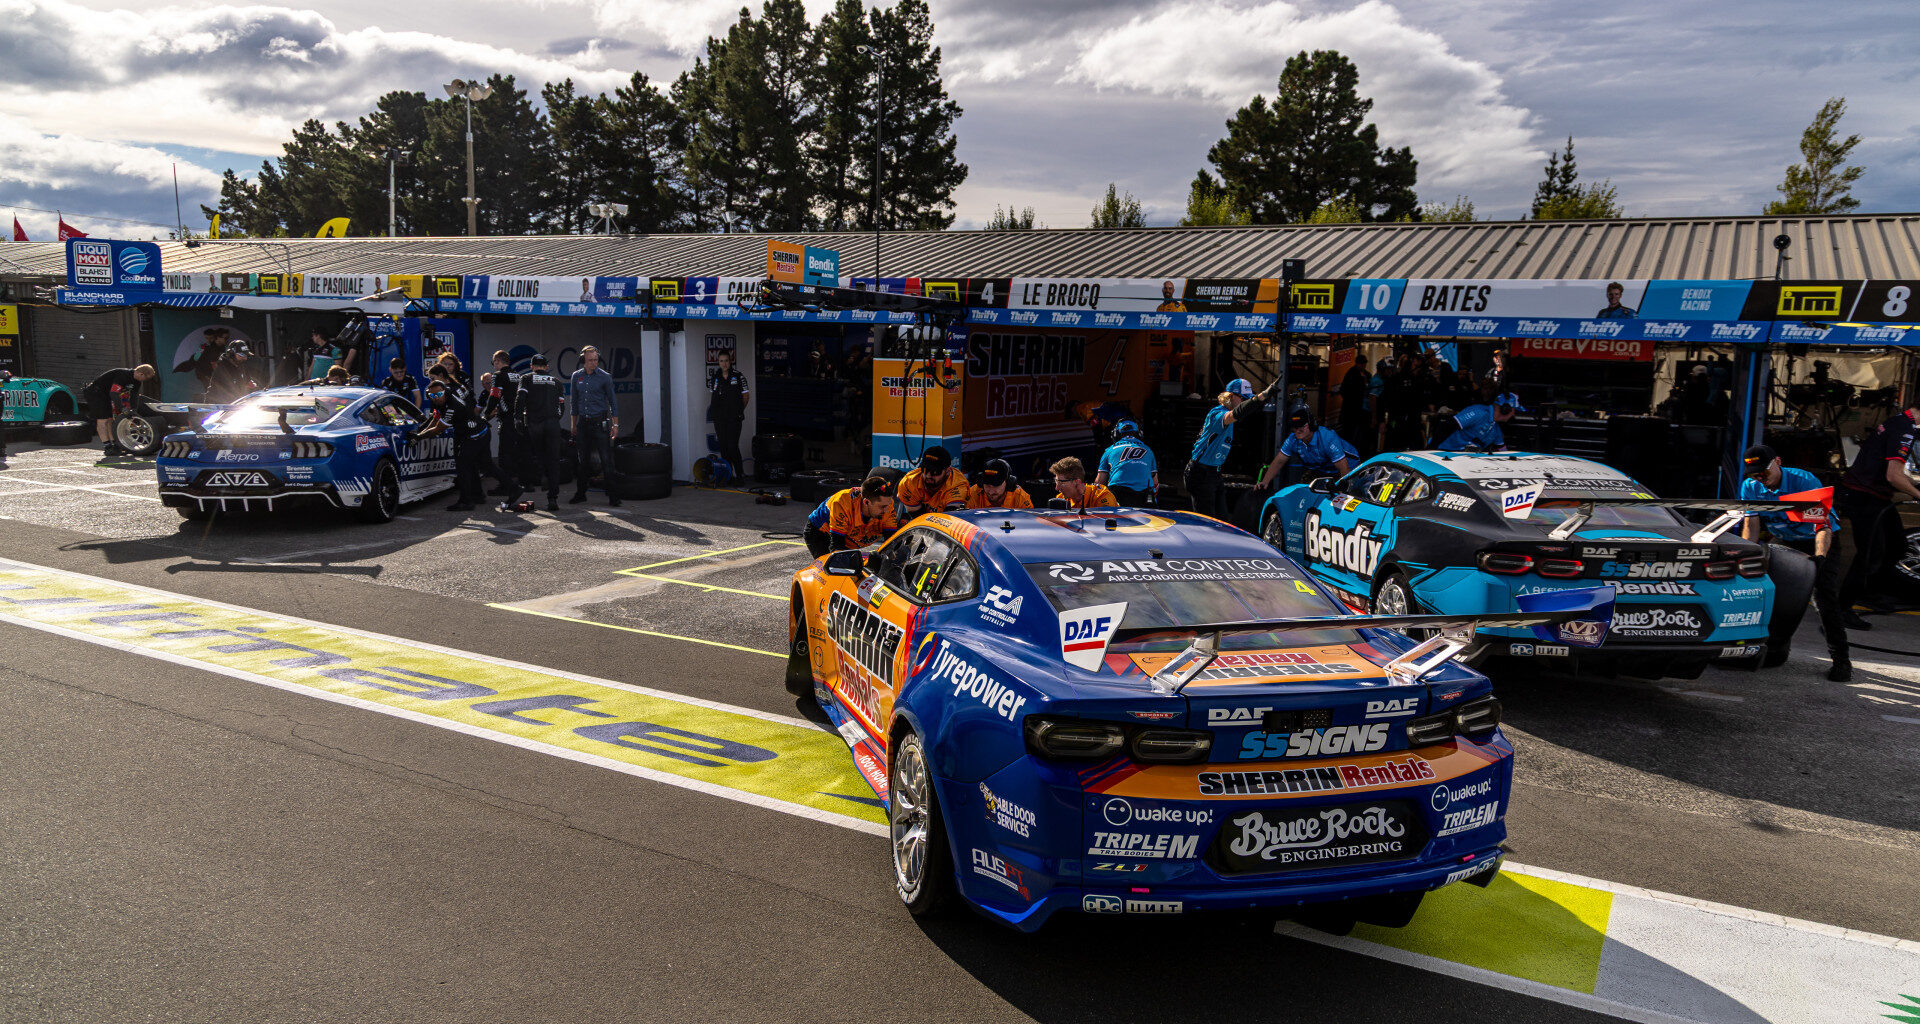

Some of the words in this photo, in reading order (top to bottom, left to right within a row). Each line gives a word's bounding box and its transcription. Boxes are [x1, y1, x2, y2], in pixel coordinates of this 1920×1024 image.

[78, 245, 107, 255] LIQUI
[772, 251, 799, 264] SHERRIN
[78, 255, 108, 264] MOLY
[809, 256, 834, 271] Bendix
[776, 262, 795, 273] Rentals
[120, 274, 156, 282] CoolDrive
[162, 274, 191, 290] EYNOLDS
[286, 276, 299, 292] 18
[310, 277, 320, 293] DE
[322, 277, 363, 295] PASQUALE
[472, 278, 480, 296] 7
[498, 280, 539, 298] GOLDING
[695, 281, 706, 301] 3
[982, 282, 994, 304] 4
[1196, 286, 1220, 295] SHERRIN
[1221, 286, 1248, 296] RENTALS
[1022, 283, 1041, 305] LE
[1046, 283, 1100, 310] BROCQ
[1359, 284, 1391, 310] 10
[1420, 285, 1492, 311] BATES
[1682, 289, 1712, 299] BENDIX
[1882, 286, 1911, 316] 8
[656, 305, 677, 316] Thrifty
[686, 306, 708, 317] Thrifty
[718, 306, 740, 318] Thrifty
[1680, 300, 1711, 310] RACING
[972, 310, 999, 321] Thrifty
[1010, 311, 1039, 323] Thrifty
[1052, 312, 1082, 324] Thrifty
[1095, 313, 1126, 326] Thrifty
[1140, 314, 1172, 327] Thrifty
[1186, 314, 1220, 328] Thrifty
[1235, 315, 1269, 329] Thrifty
[1293, 316, 1330, 330] Thrifty
[1346, 317, 1384, 331] Thrifty
[1401, 318, 1441, 332] Thrifty
[1457, 319, 1499, 333] Thrifty
[1517, 320, 1560, 335] Thrifty
[1579, 321, 1624, 336] Thrifty
[1644, 322, 1691, 338] Thrifty
[1711, 323, 1762, 339] Thrifty
[1781, 324, 1833, 340] Thrifty
[1855, 326, 1907, 342] Thrifty
[708, 338, 734, 349] LIQUI
[1523, 338, 1641, 354] retravision
[968, 332, 1086, 378] SHERRIN
[1102, 336, 1129, 396] 4
[881, 377, 935, 389] SHERRIN
[5, 390, 39, 407] RIVER
[889, 388, 927, 397] Rentals
[986, 376, 1068, 419] Rentals
[215, 450, 258, 462] Aerpro
[880, 455, 923, 469] Bend
[1120, 447, 1147, 462] 10
[412, 462, 431, 473] AUTO
[433, 461, 455, 471] PARTS
[1554, 479, 1634, 488] CONTROL
[1380, 482, 1394, 502] 10
[1504, 491, 1535, 507] DAF
[1439, 502, 1468, 512] CRANES
[1307, 512, 1382, 576] Bendix
[1677, 548, 1711, 556] DAF
[1102, 559, 1166, 573] AIR
[1166, 558, 1286, 572] CONTROL
[916, 567, 930, 596] 4
[1108, 573, 1223, 582] AIR-CONDITIONING
[1224, 572, 1291, 580] ELECTRICAL
[1293, 580, 1316, 596] 4
[1603, 581, 1699, 595] Bendix
[1732, 588, 1764, 597] AFFINITY
[983, 585, 1023, 616] PCA
[978, 605, 989, 613] PUMP
[989, 609, 1016, 624] CONTROLLERS
[981, 614, 1005, 627] AUSTRALIA
[1611, 612, 1649, 627] ruce
[1649, 608, 1700, 628] Rock
[1064, 616, 1111, 641] DAF
[1624, 629, 1699, 637] ENGINEERING
[827, 590, 905, 690] SHERRIN
[931, 640, 1026, 722] Tyrepower
[837, 648, 883, 734] Rentals
[1366, 698, 1418, 713] DAF
[1208, 707, 1273, 720] DAF
[1198, 767, 1344, 795] SHERRIN
[1340, 758, 1436, 788] Rentals
[1450, 785, 1476, 802] wake
[1478, 778, 1491, 798] up!
[997, 798, 1013, 816] ABLE
[1014, 804, 1036, 827] DOOR
[1135, 808, 1182, 822] wake
[1186, 809, 1213, 825] up!
[997, 812, 1029, 838] SERVICES
[1230, 812, 1320, 856] Bruce
[1320, 807, 1405, 840] Rock
[1281, 841, 1402, 863] ENGINEERING
[1092, 863, 1148, 872] ZL1
